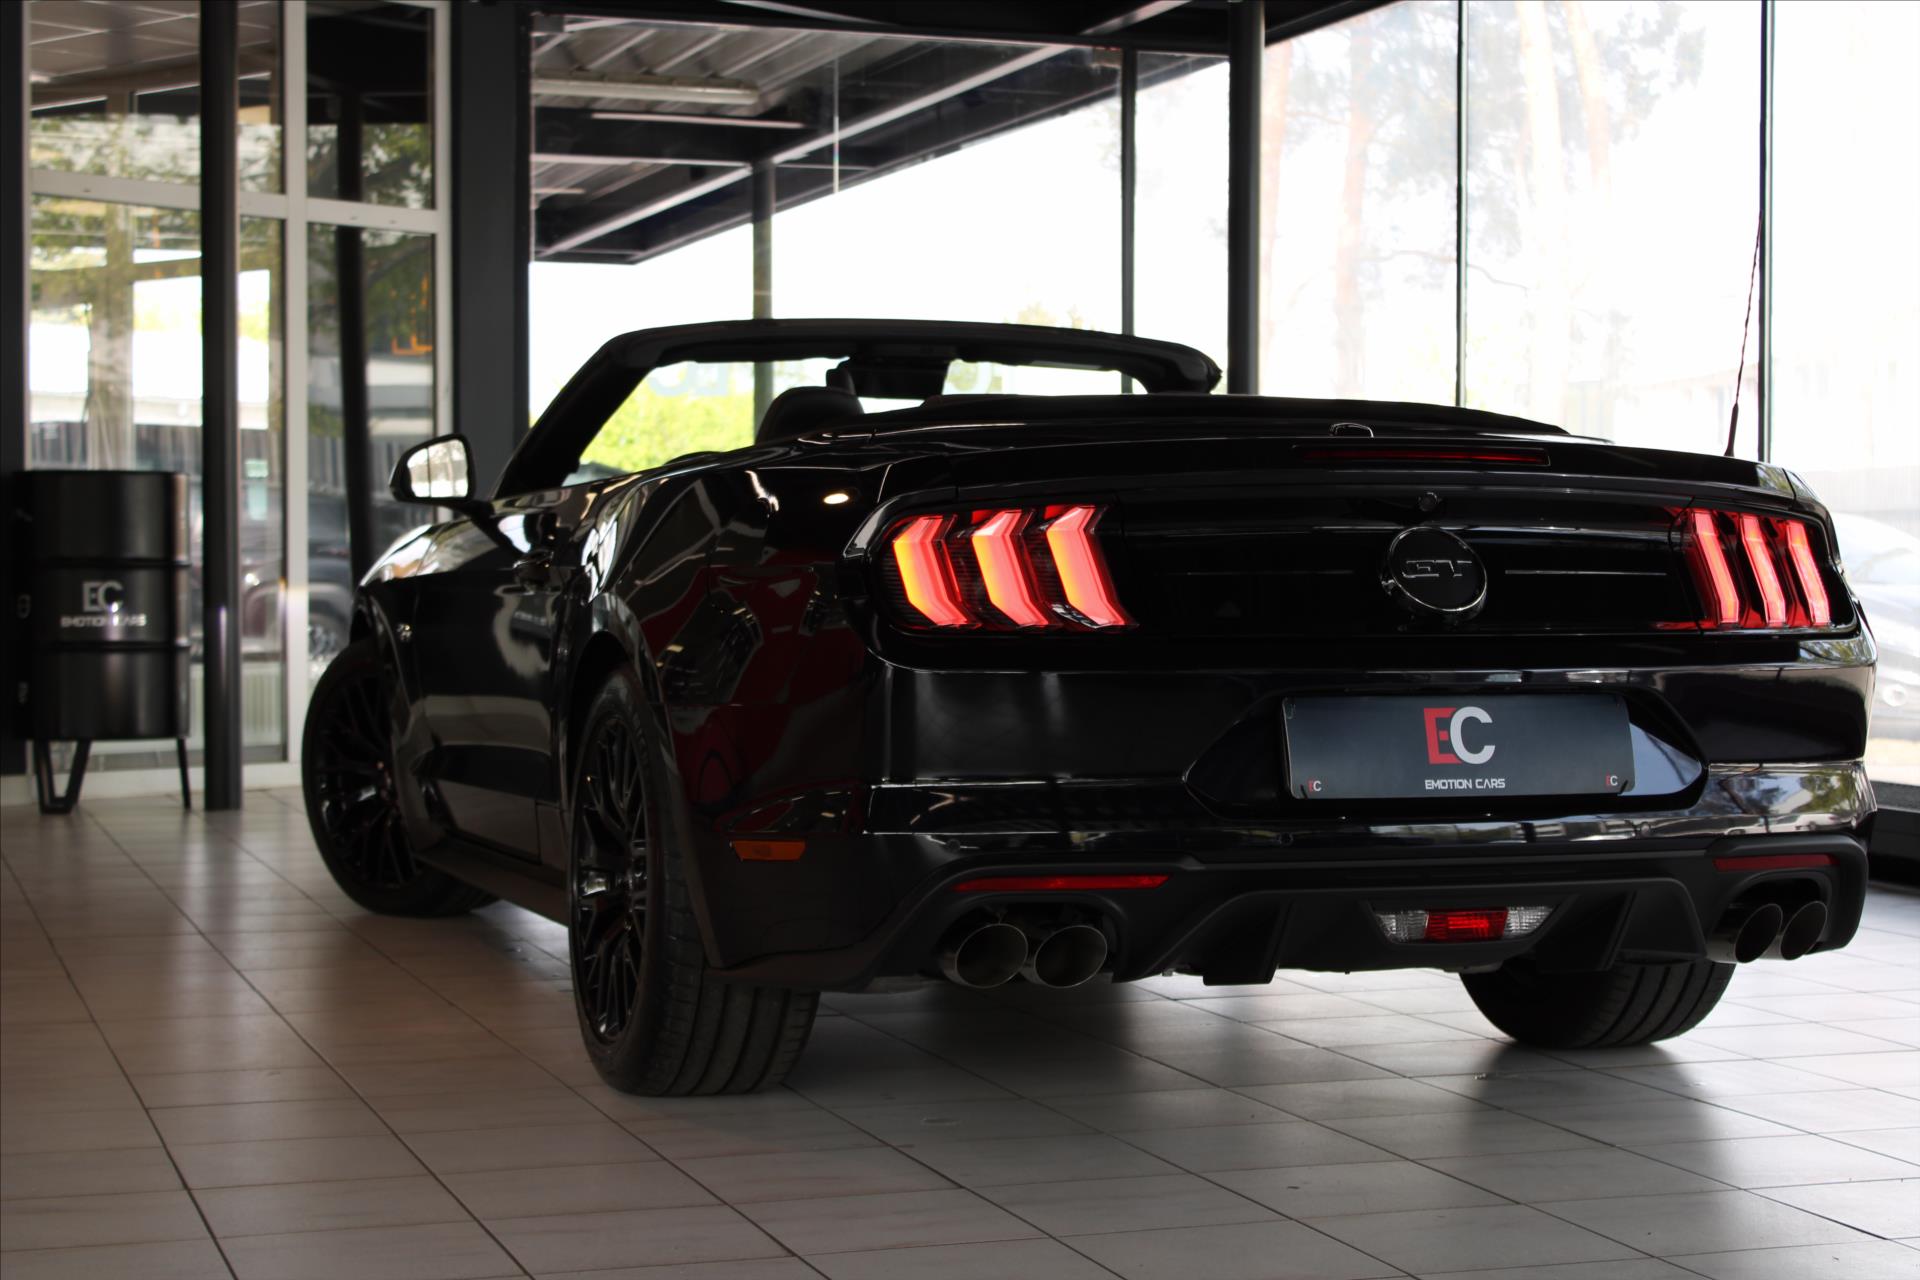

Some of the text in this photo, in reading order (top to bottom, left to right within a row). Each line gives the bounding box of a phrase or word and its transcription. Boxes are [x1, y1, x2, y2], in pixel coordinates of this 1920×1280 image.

[1402, 559, 1472, 578] GT
[82, 580, 124, 612] EC
[1423, 706, 1496, 765] EC
[1425, 778, 1506, 789] EMOTION CARS
